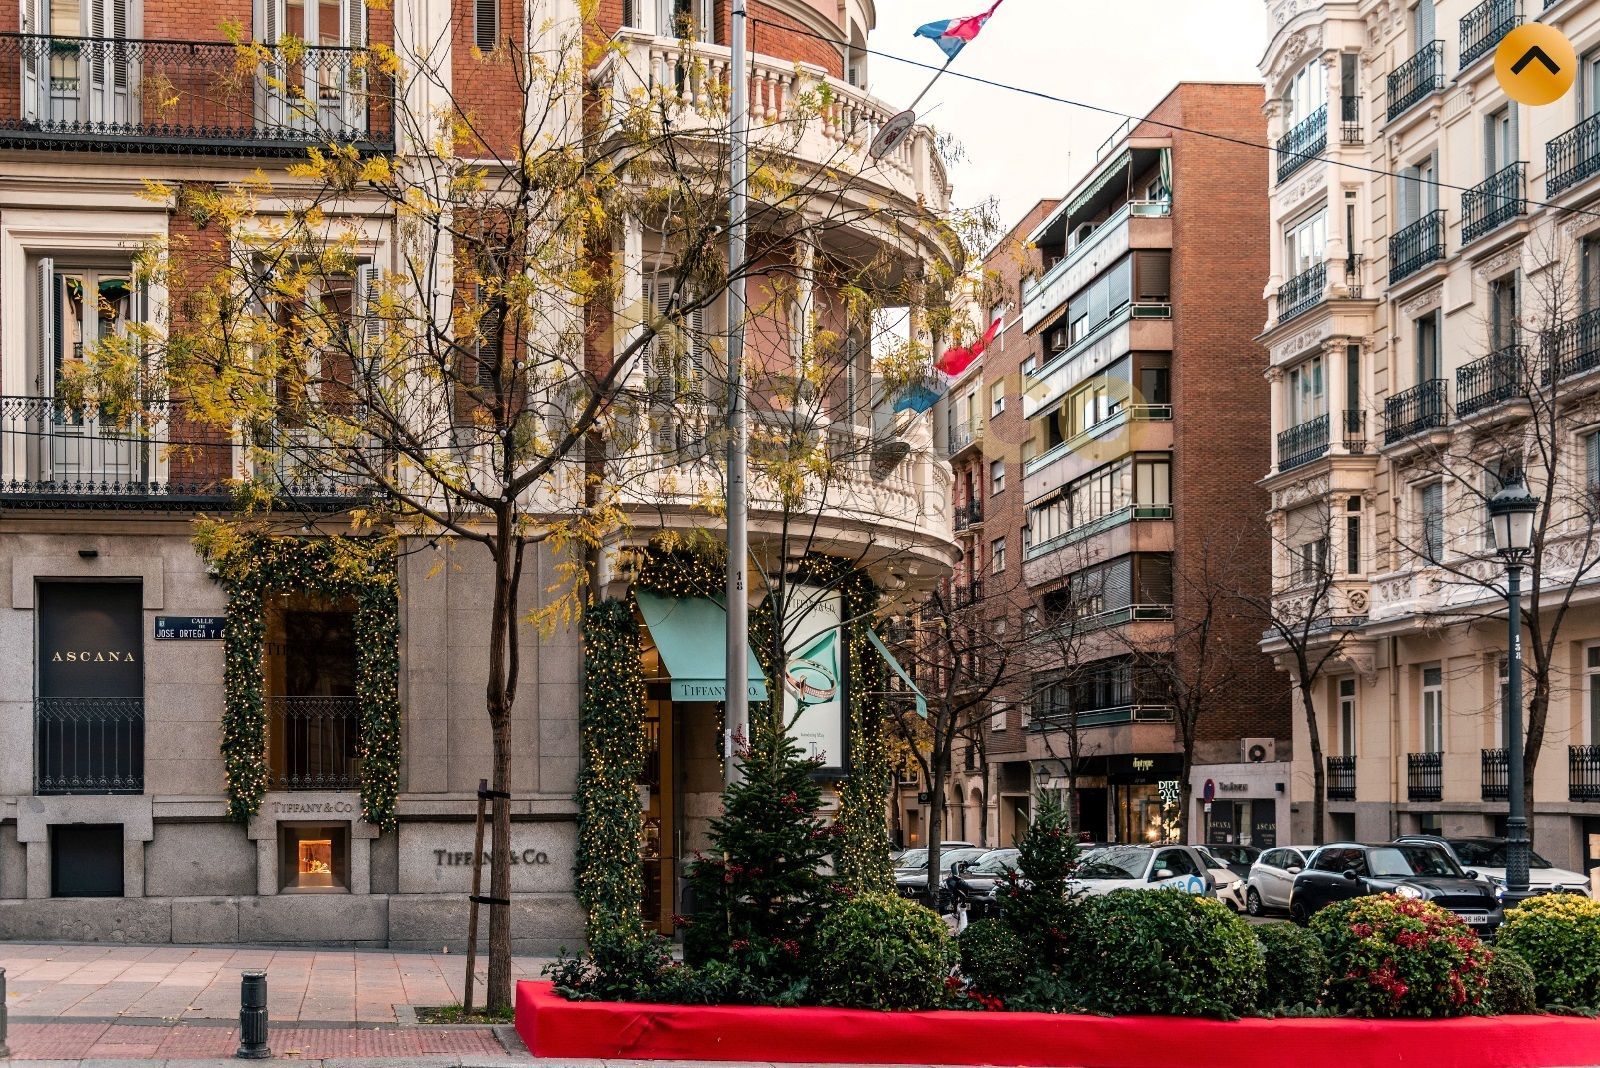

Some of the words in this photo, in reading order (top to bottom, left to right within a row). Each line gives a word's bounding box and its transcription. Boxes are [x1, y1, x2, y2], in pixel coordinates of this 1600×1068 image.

[156, 629, 175, 638] JOSE
[179, 629, 206, 638] ORTEGA
[210, 629, 216, 638] Y
[52, 651, 135, 662] ASCANA
[272, 801, 322, 813] TIFFANY
[433, 848, 505, 866] TIFFN
